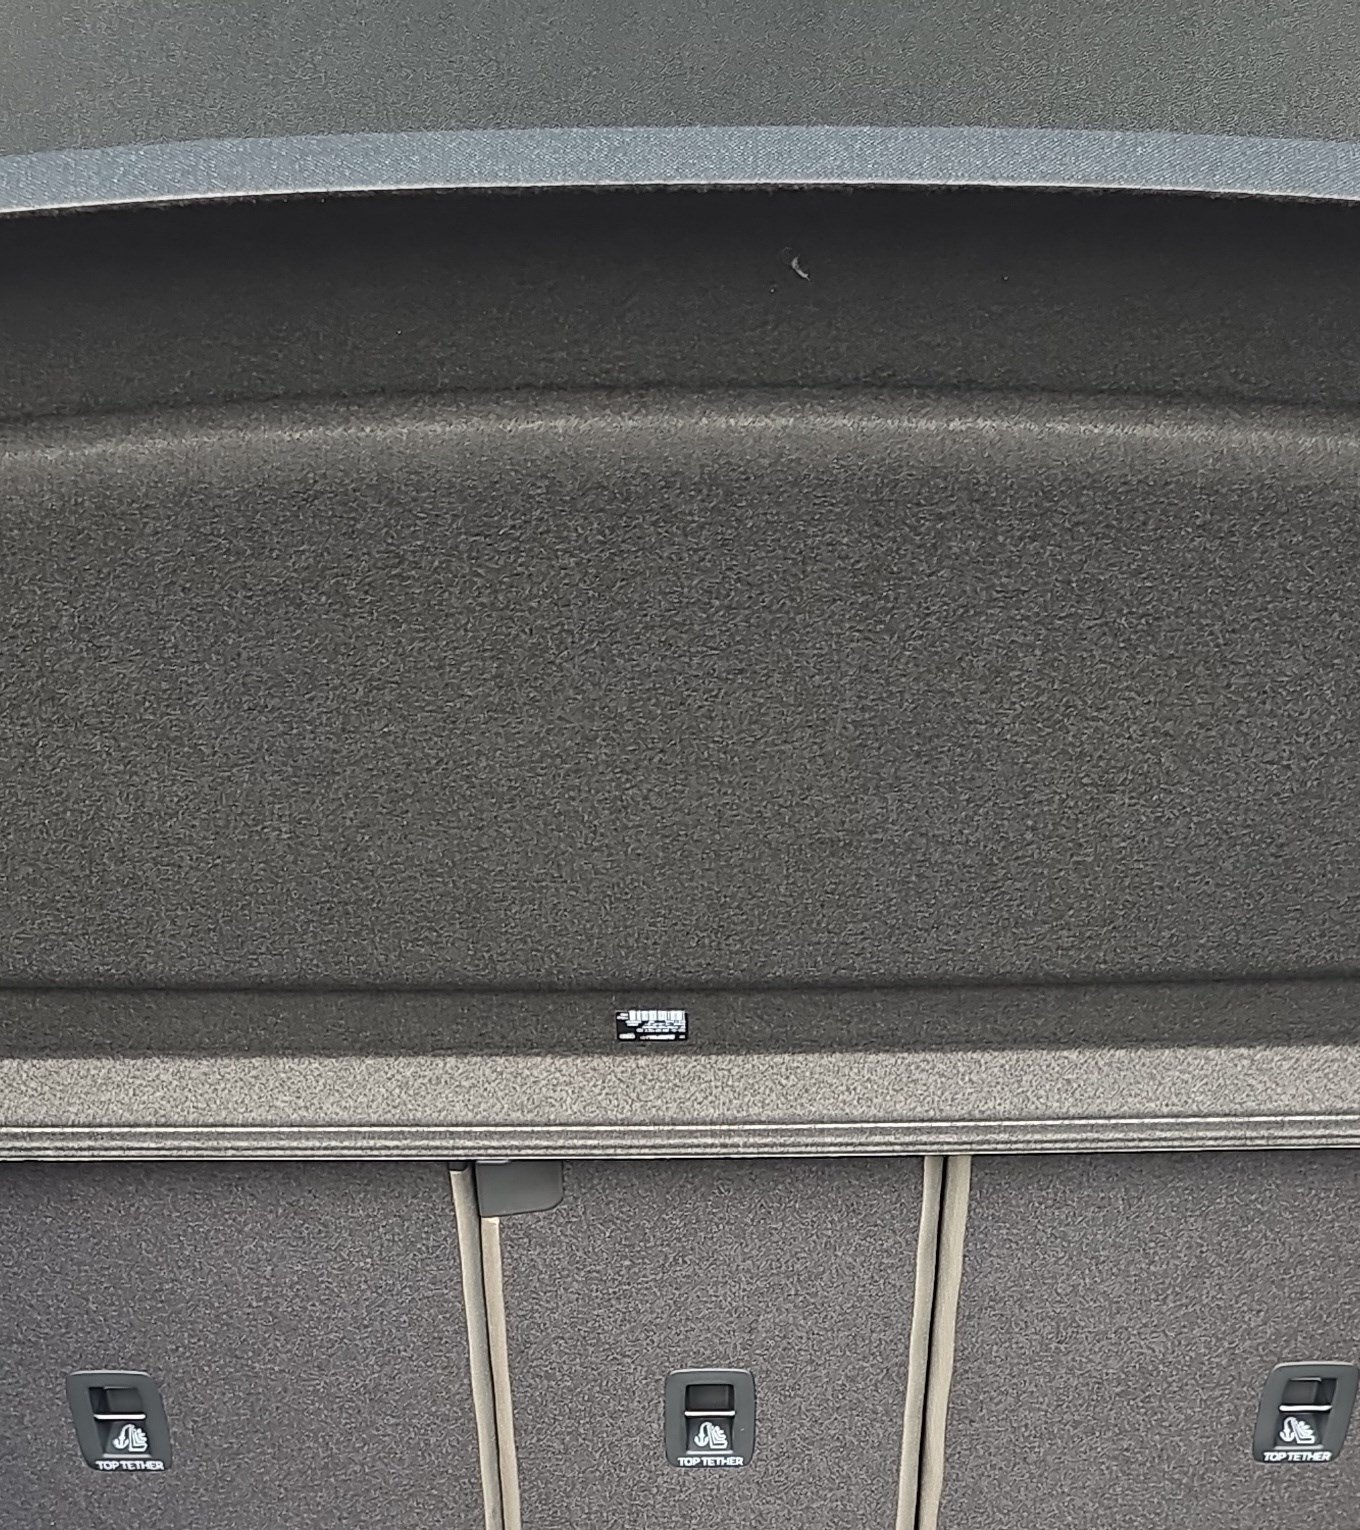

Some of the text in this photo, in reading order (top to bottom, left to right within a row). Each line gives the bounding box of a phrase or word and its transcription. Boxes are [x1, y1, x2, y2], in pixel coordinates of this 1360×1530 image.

[1263, 1451, 1332, 1461] TOP TETHER
[95, 1460, 164, 1470] TOP TETHER
[676, 1456, 743, 1467] TOP TETHER
